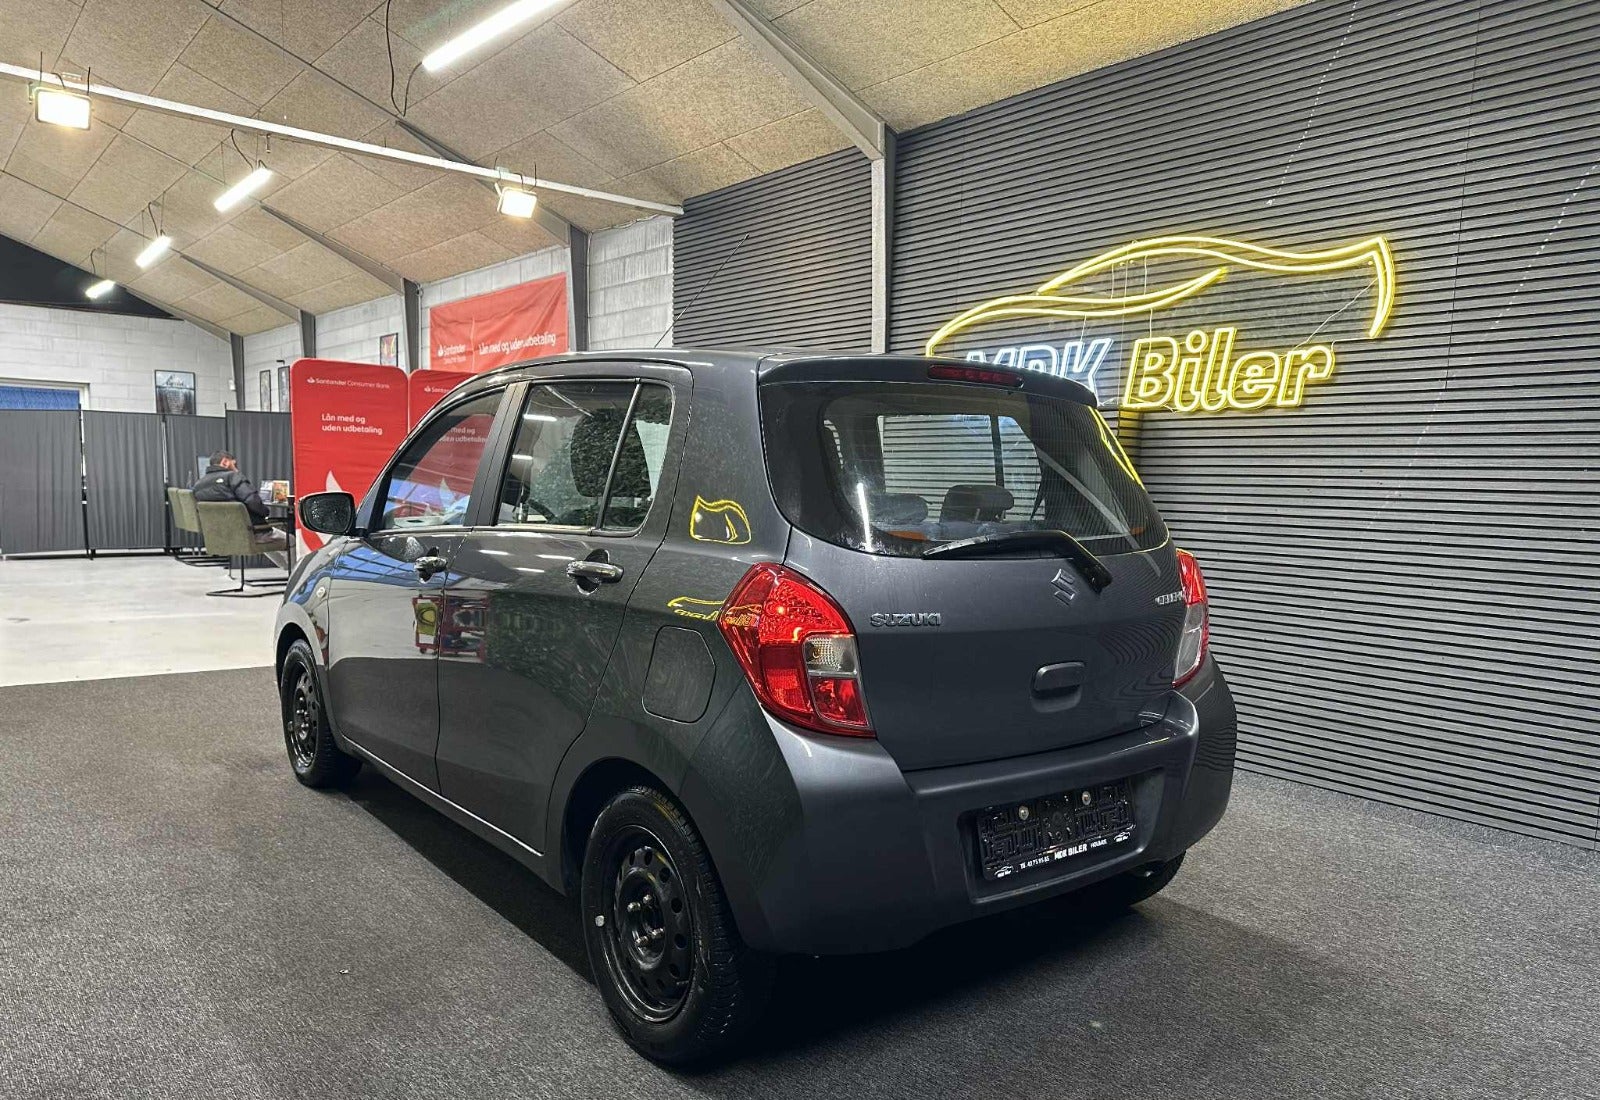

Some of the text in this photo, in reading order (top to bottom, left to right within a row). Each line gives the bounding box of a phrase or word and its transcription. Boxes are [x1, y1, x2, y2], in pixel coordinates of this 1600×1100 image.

[1122, 327, 1336, 412] Biler
[321, 413, 366, 424] Lån med og
[322, 424, 383, 436] uden udbetaling
[871, 612, 941, 627] SUZUKI
[1068, 843, 1088, 856] BILER
